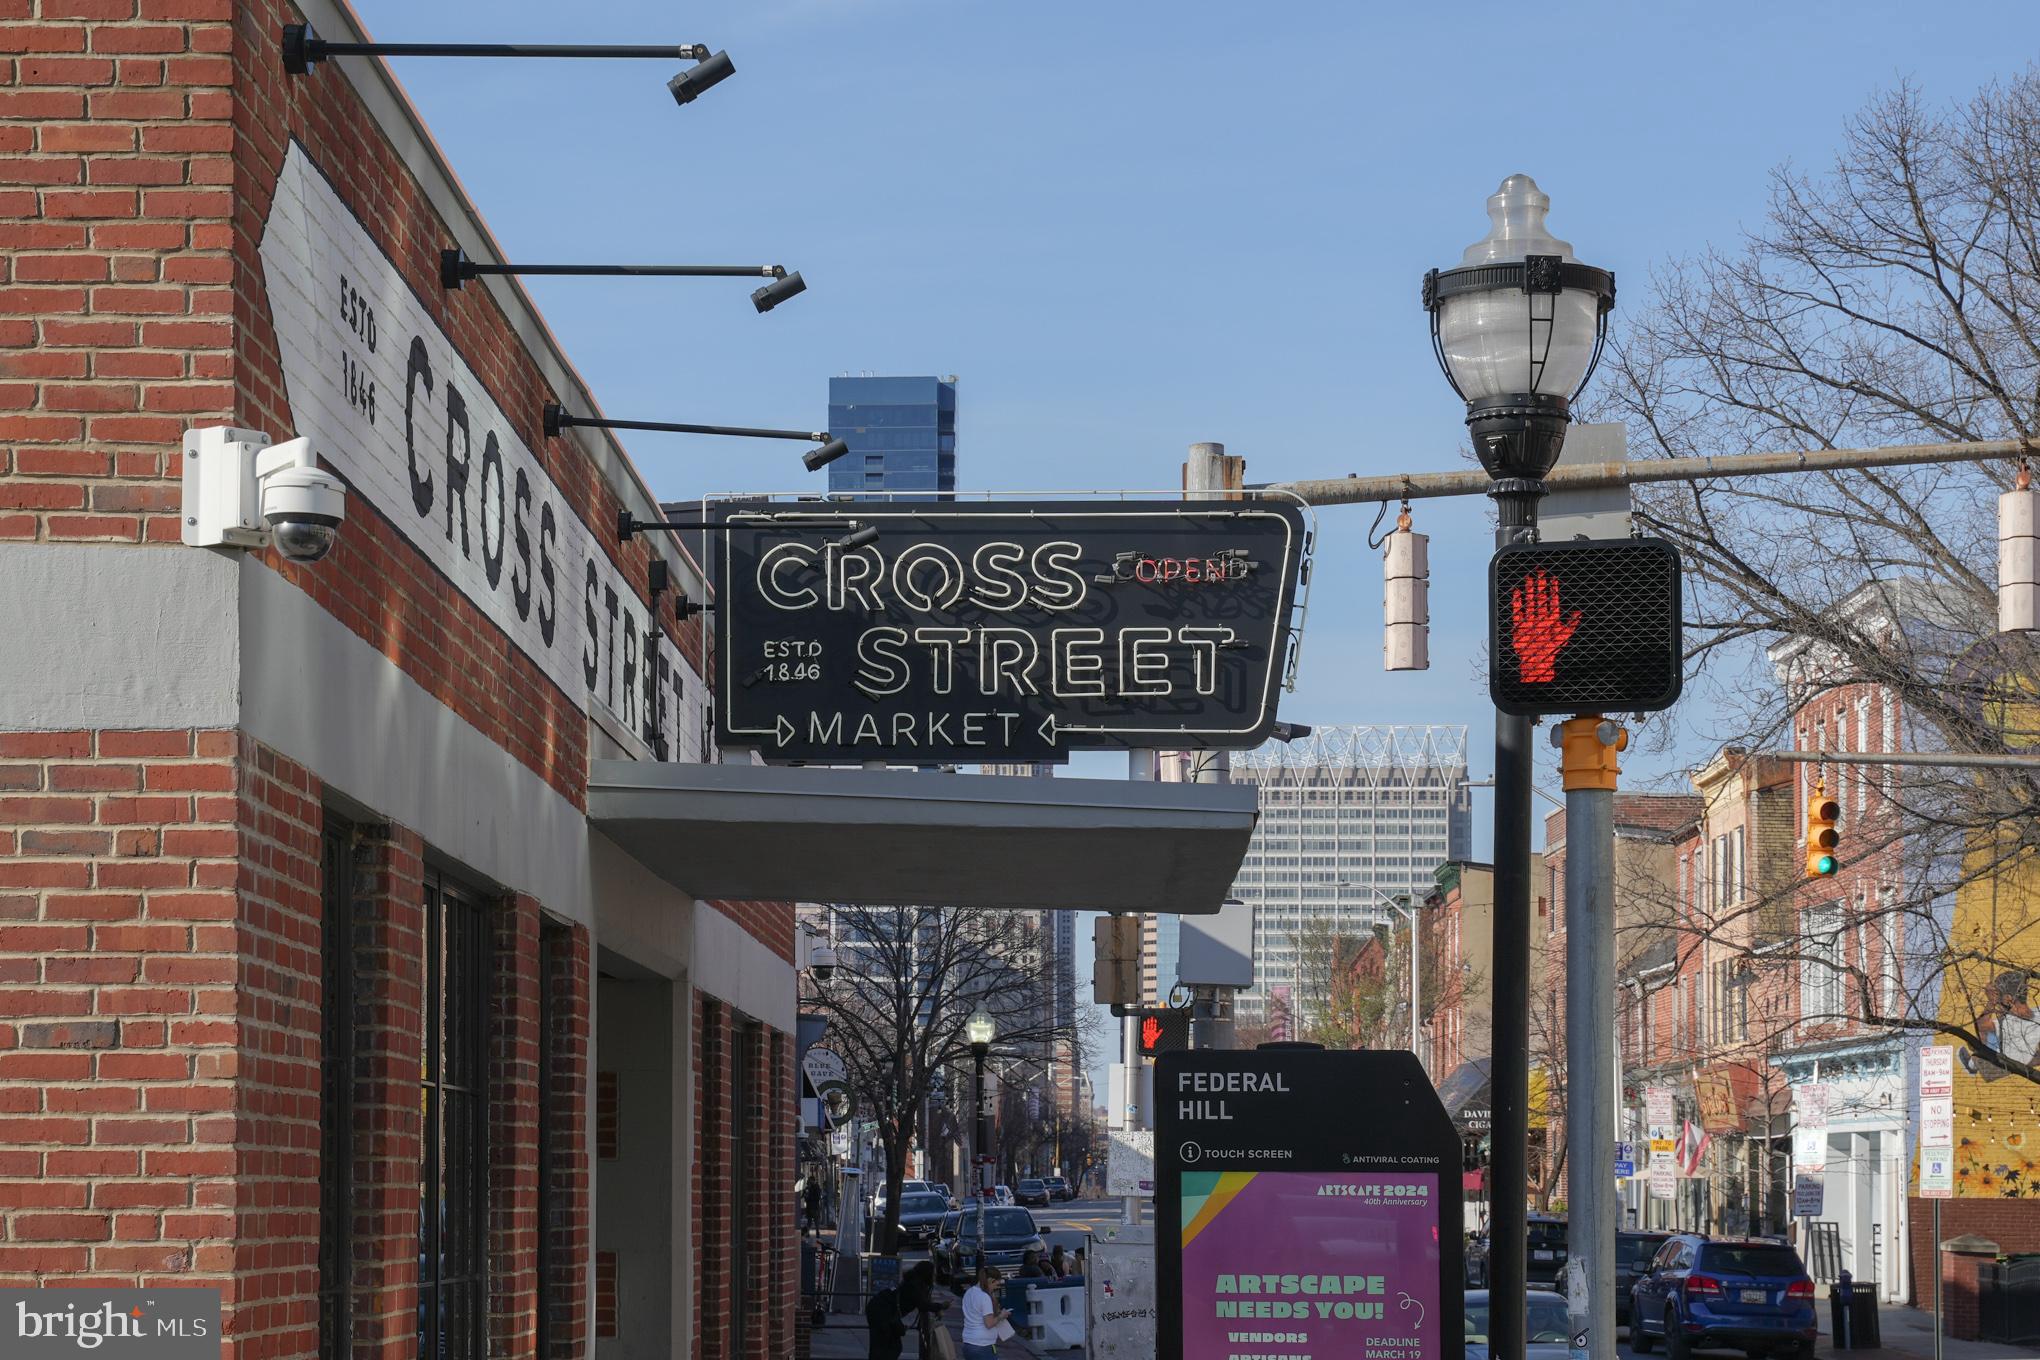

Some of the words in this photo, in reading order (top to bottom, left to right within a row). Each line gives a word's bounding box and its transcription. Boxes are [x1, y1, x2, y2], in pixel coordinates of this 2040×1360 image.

[340, 273, 376, 354] ESTD
[342, 350, 375, 426] 1846
[405, 335, 556, 649] CROSS
[757, 541, 1087, 612] CROSS
[1136, 558, 1227, 582] OPEN
[763, 640, 823, 658] ESTD
[854, 626, 1236, 698] STREET
[763, 662, 821, 682] 1846
[809, 711, 1020, 747] MARKET
[1178, 1072, 1290, 1092] FEDERAL
[1178, 1100, 1233, 1120] HILL
[1930, 1106, 1942, 1115] NO
[1923, 1119, 1950, 1129] STOPPING
[1204, 1149, 1245, 1159] TOUCH
[1247, 1149, 1292, 1159] SCREEN
[1352, 1156, 1399, 1164] ANTIVIRAL
[1400, 1156, 1440, 1164] COATING
[1317, 1184, 1381, 1196] ARTSCAPE
[1383, 1185, 1428, 1196] 2024
[1383, 1198, 1428, 1207] Anniversary
[1215, 1274, 1385, 1295] ARTSCAPE
[1215, 1301, 1310, 1319] NEEDS
[1314, 1302, 1384, 1320] YOU!
[1228, 1332, 1308, 1343] VENDORS
[1366, 1338, 1420, 1347] DEADLINE
[1365, 1350, 1406, 1359] MARCH
[1408, 1351, 1422, 1359] 19
